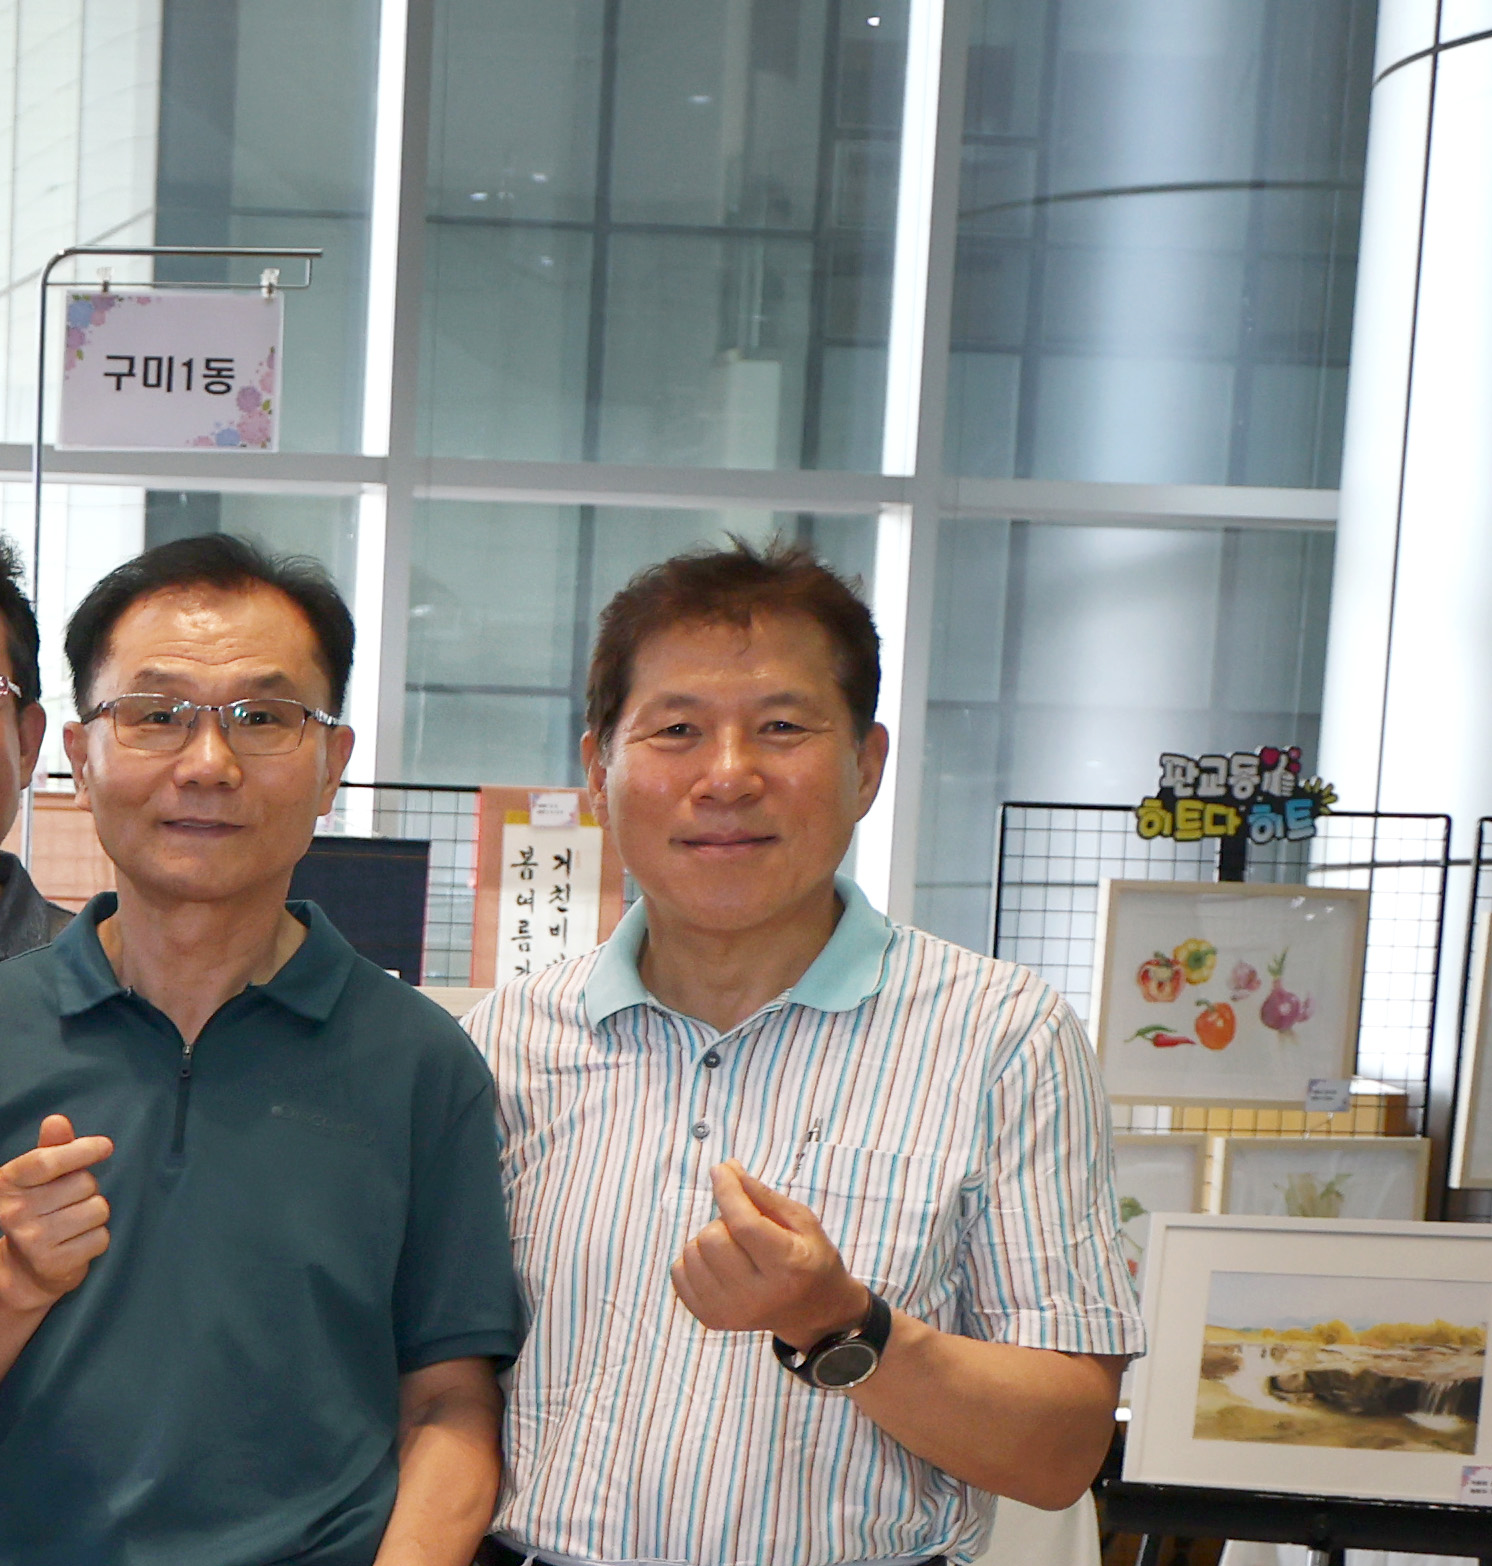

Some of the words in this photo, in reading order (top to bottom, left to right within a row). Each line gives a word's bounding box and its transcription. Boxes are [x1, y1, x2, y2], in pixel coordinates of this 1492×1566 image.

[103, 355, 236, 395] 구미1동
[1161, 753, 1261, 800] 판교동
[1137, 797, 1242, 841] 히트다
[1248, 799, 1316, 844] 히트
